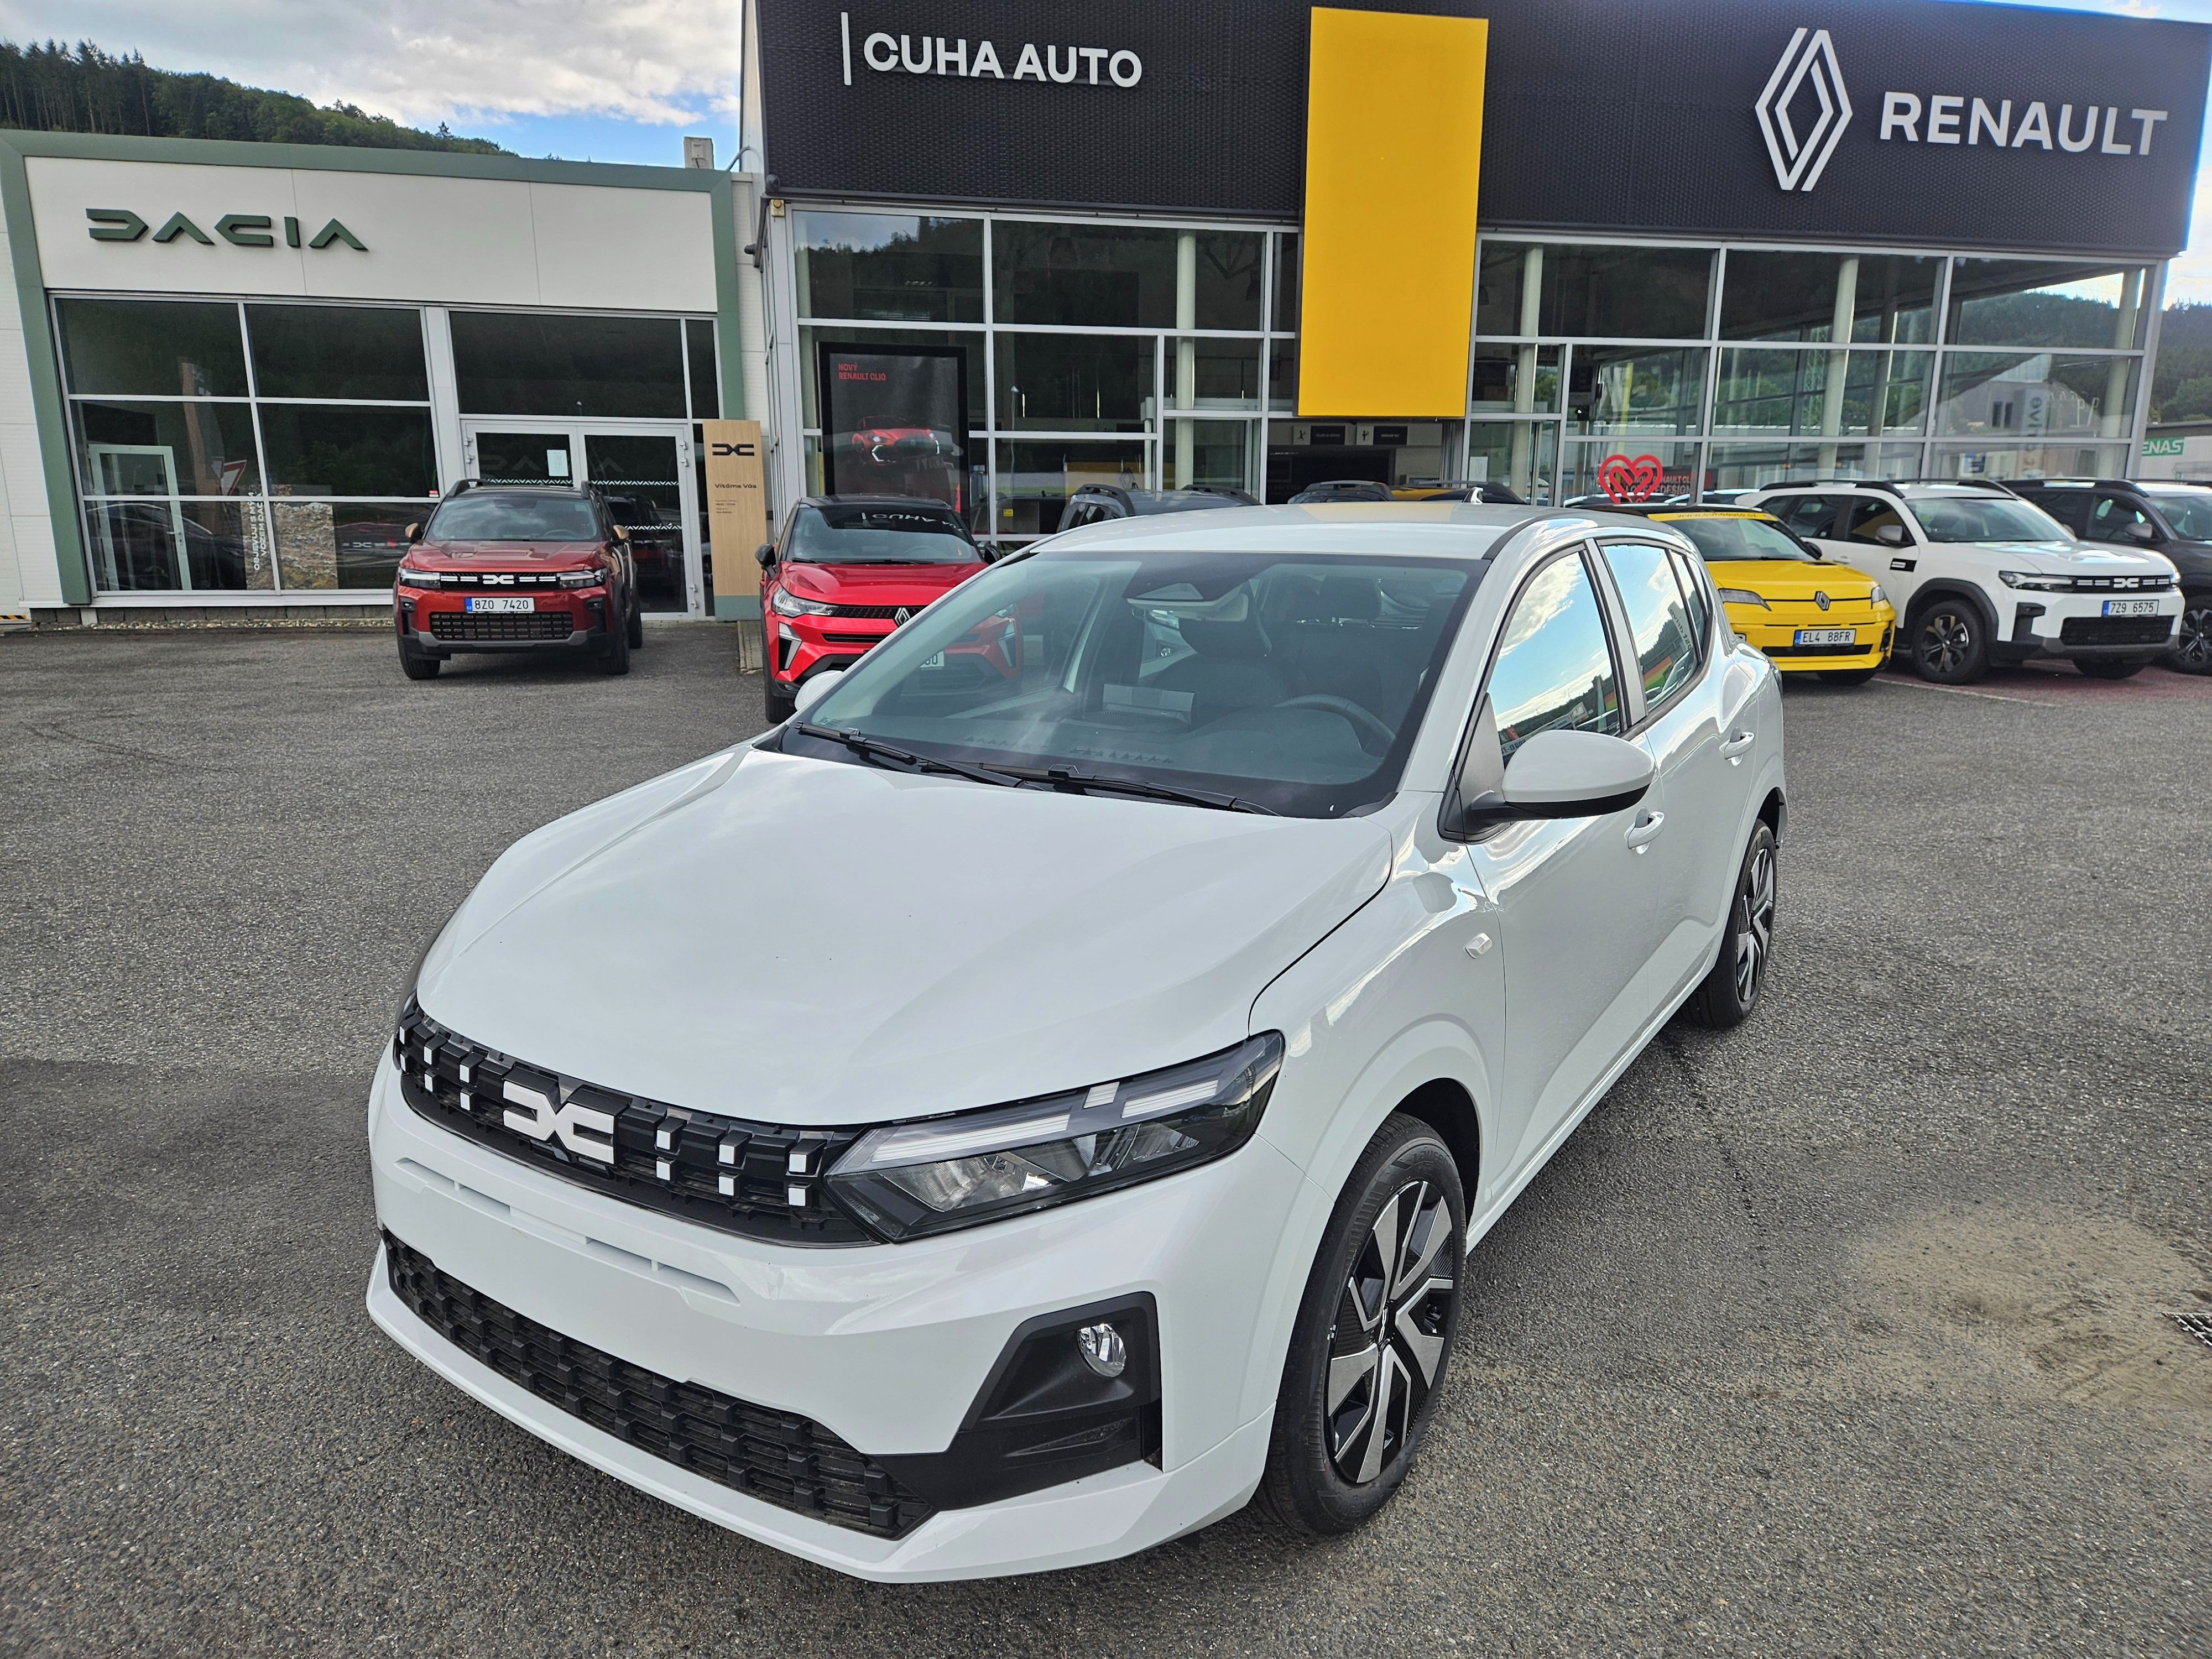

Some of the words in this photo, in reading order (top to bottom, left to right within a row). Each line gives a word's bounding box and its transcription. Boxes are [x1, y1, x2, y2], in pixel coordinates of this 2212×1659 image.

[864, 32, 1004, 79] CUHA
[1013, 43, 1142, 87] AUTO
[1880, 92, 2168, 155] RENAULT
[86, 208, 369, 252] DACIA
[838, 362, 858, 371] NOVÝ
[251, 523, 260, 570] OBJEVUJI
[258, 523, 267, 557] VOZEM
[502, 600, 529, 609] 7420
[2111, 603, 2126, 613] 7Z9
[2133, 602, 2154, 613] 6575
[1803, 632, 1820, 643] EL4
[1828, 632, 1851, 642] 88FR
